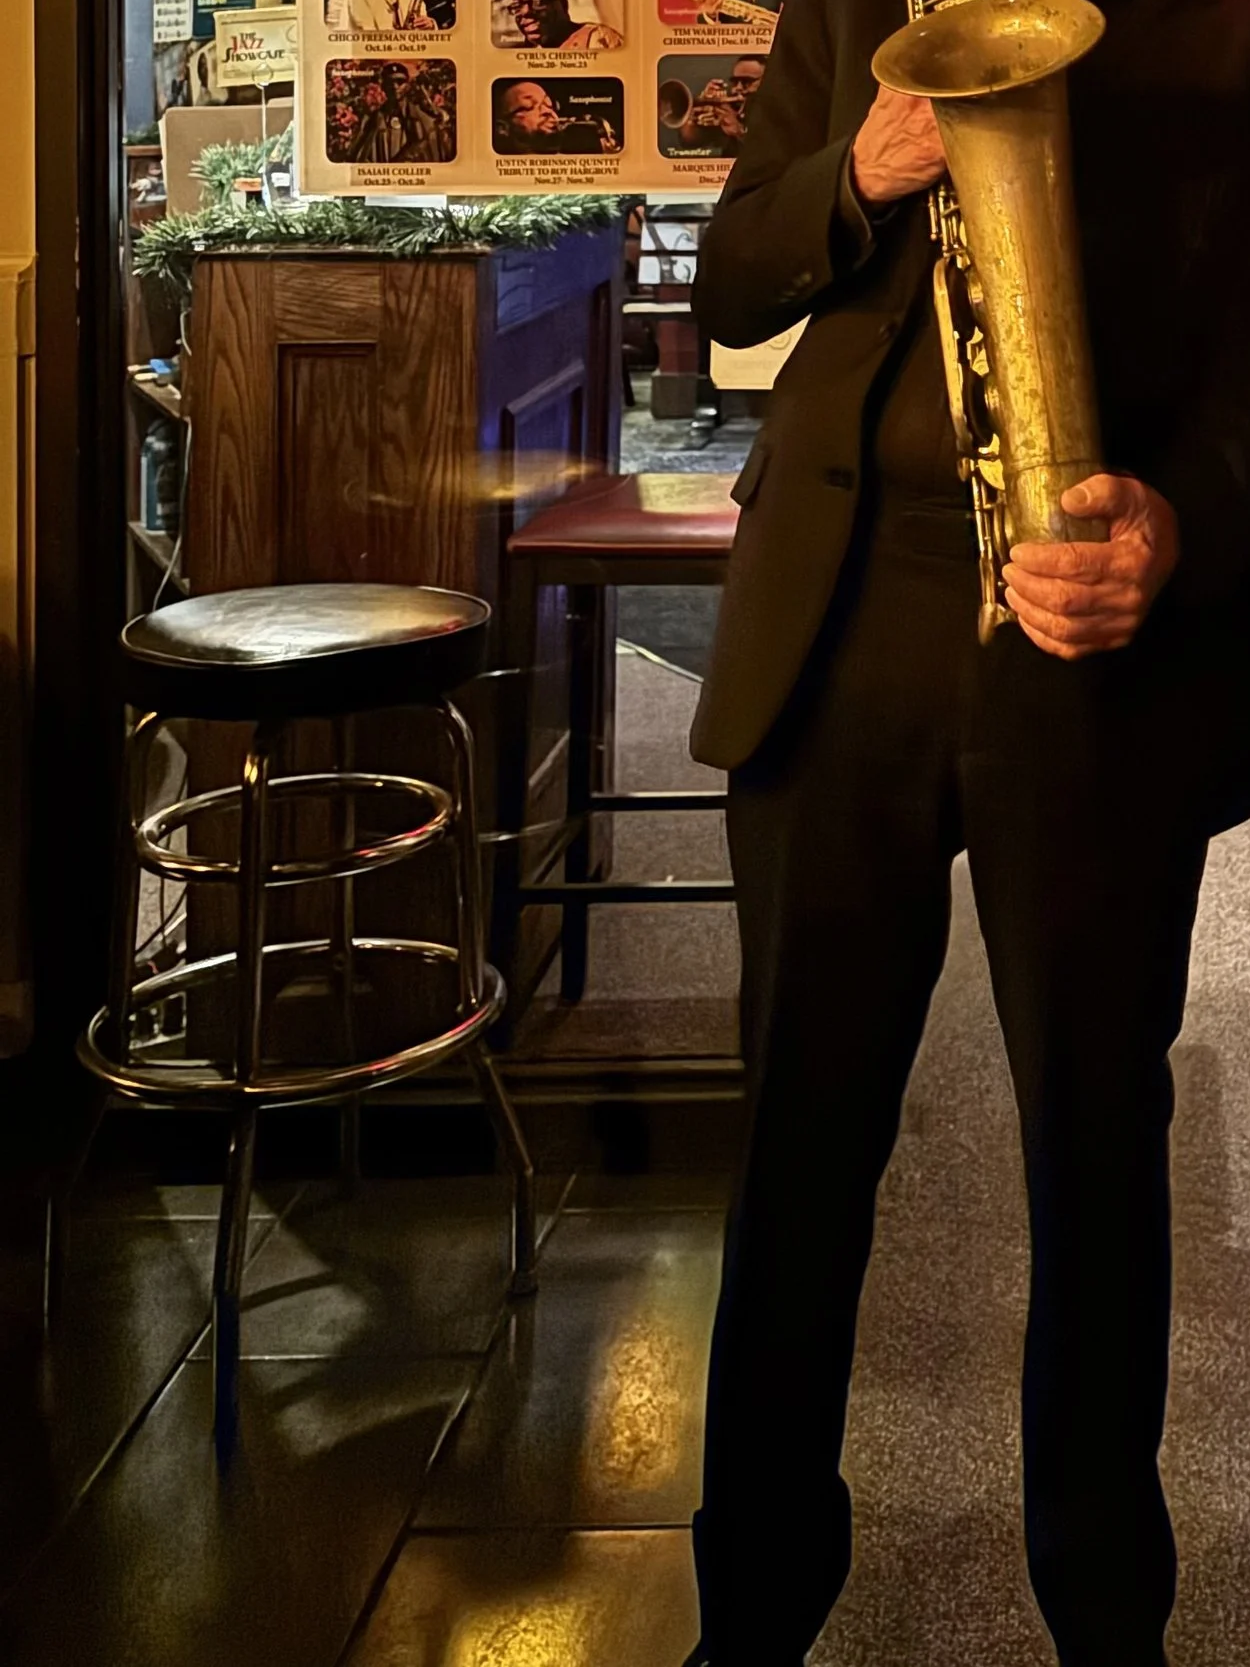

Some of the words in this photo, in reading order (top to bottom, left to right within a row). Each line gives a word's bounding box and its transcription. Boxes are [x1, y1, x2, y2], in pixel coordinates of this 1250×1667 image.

[673, 27, 691, 36] TIM
[692, 27, 745, 37] WARFIELD'S
[746, 27, 774, 37] JAZZY
[328, 34, 360, 42] CHICO
[361, 34, 406, 42] FREEMAN
[407, 34, 453, 43] QUARTET
[662, 37, 716, 46] CHRISTMAS
[516, 52, 547, 61] CYRUS
[548, 52, 599, 61] CHESTNUT
[495, 158, 528, 168] JUSTIN
[529, 158, 577, 167] ROBINSON
[578, 158, 621, 167] QUINTET
[357, 167, 390, 176] ISAIAH
[391, 167, 432, 176] COLLIER
[498, 167, 538, 176] TRIBUTE
[537, 167, 550, 175] TO
[569, 167, 620, 175] HARGROVE
[672, 164, 715, 173] MARQUIS
